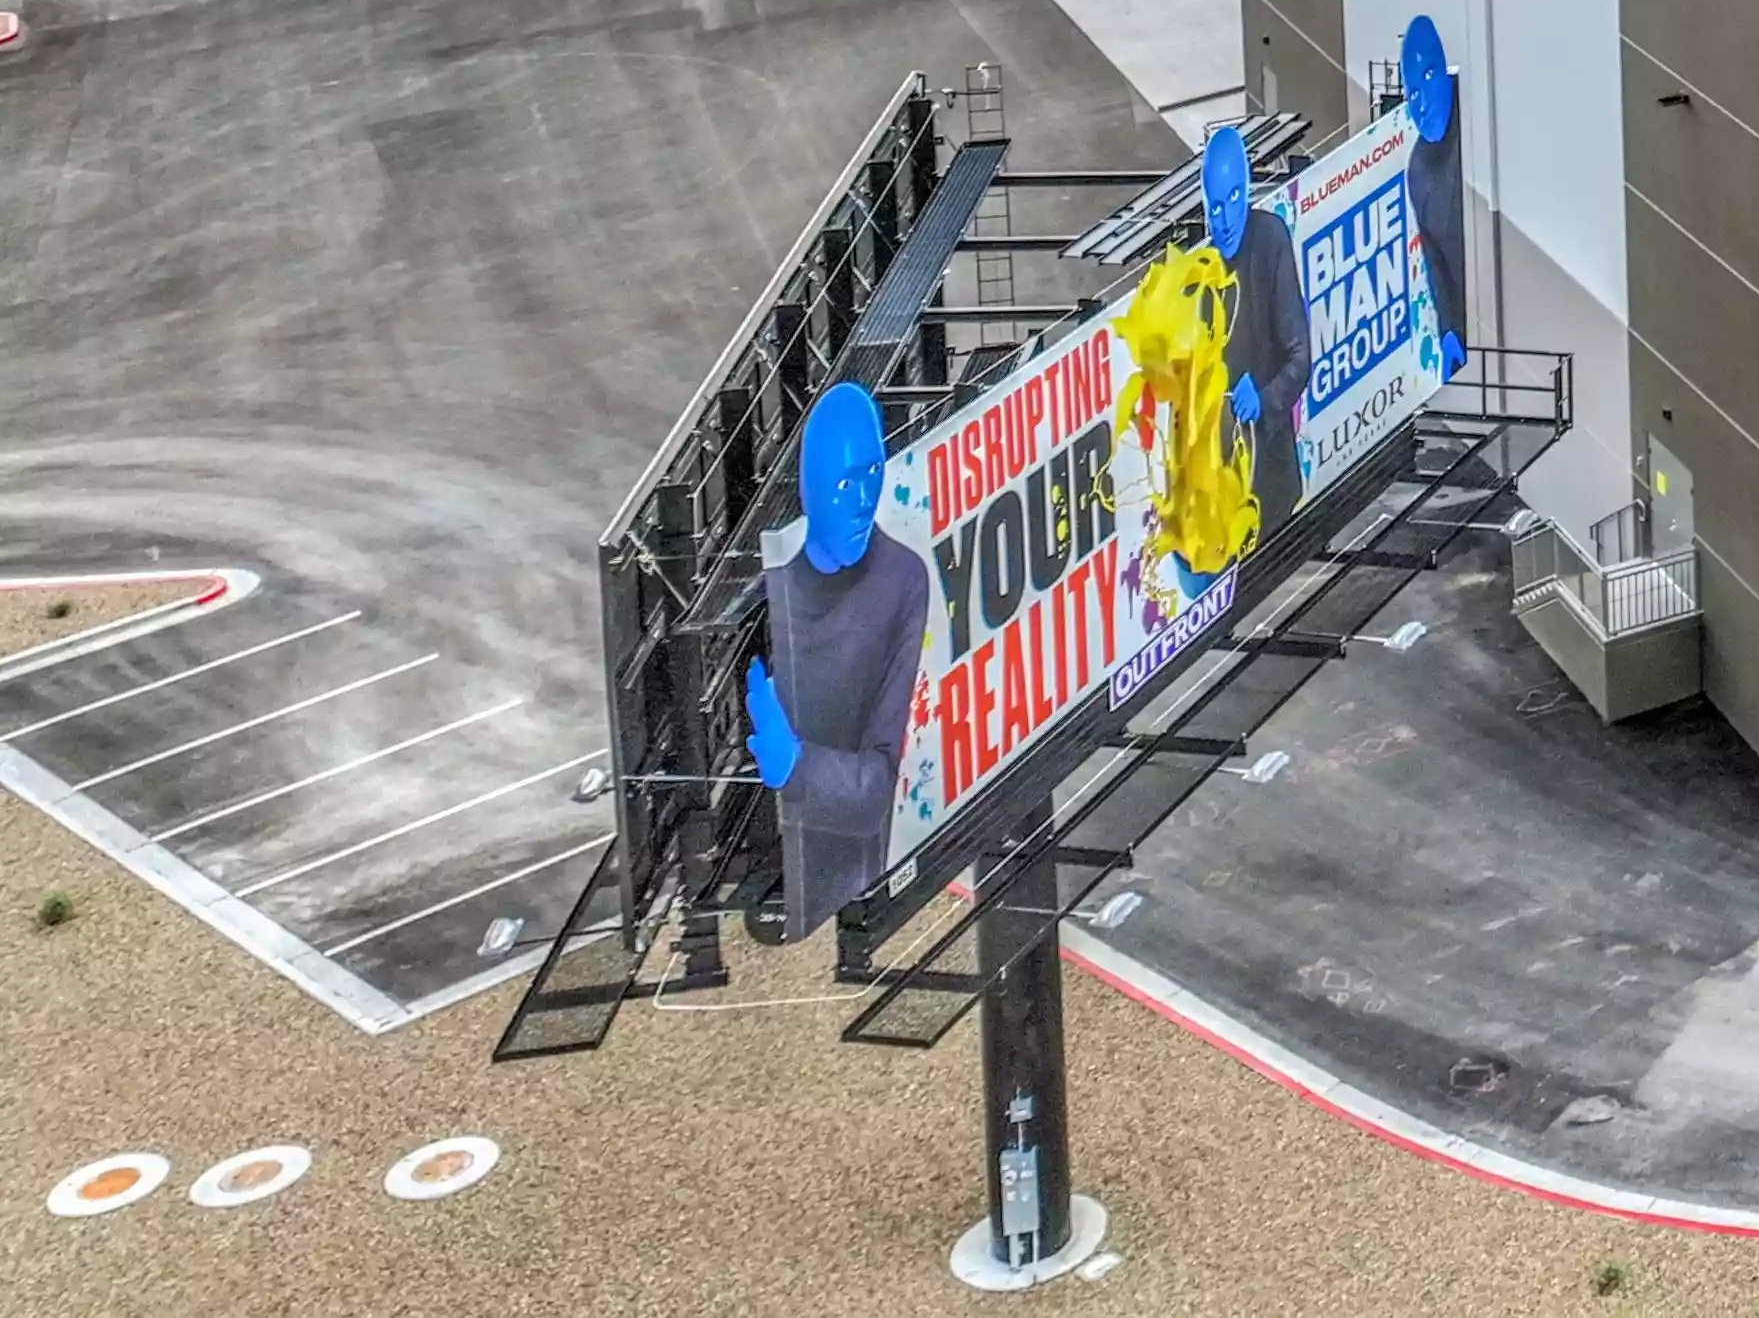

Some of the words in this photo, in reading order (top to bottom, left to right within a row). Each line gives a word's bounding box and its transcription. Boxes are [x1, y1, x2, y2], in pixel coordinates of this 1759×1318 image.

[1300, 131, 1404, 215] BLUEMAN.COM
[1307, 185, 1402, 298] BLUE
[1309, 236, 1404, 356] MAN
[927, 327, 1113, 538] DISRUPTING
[1317, 375, 1404, 468] LUXOR
[931, 420, 1116, 665] YOUR
[937, 537, 1118, 809] REALITY
[1115, 573, 1233, 697] OUTFRONT
